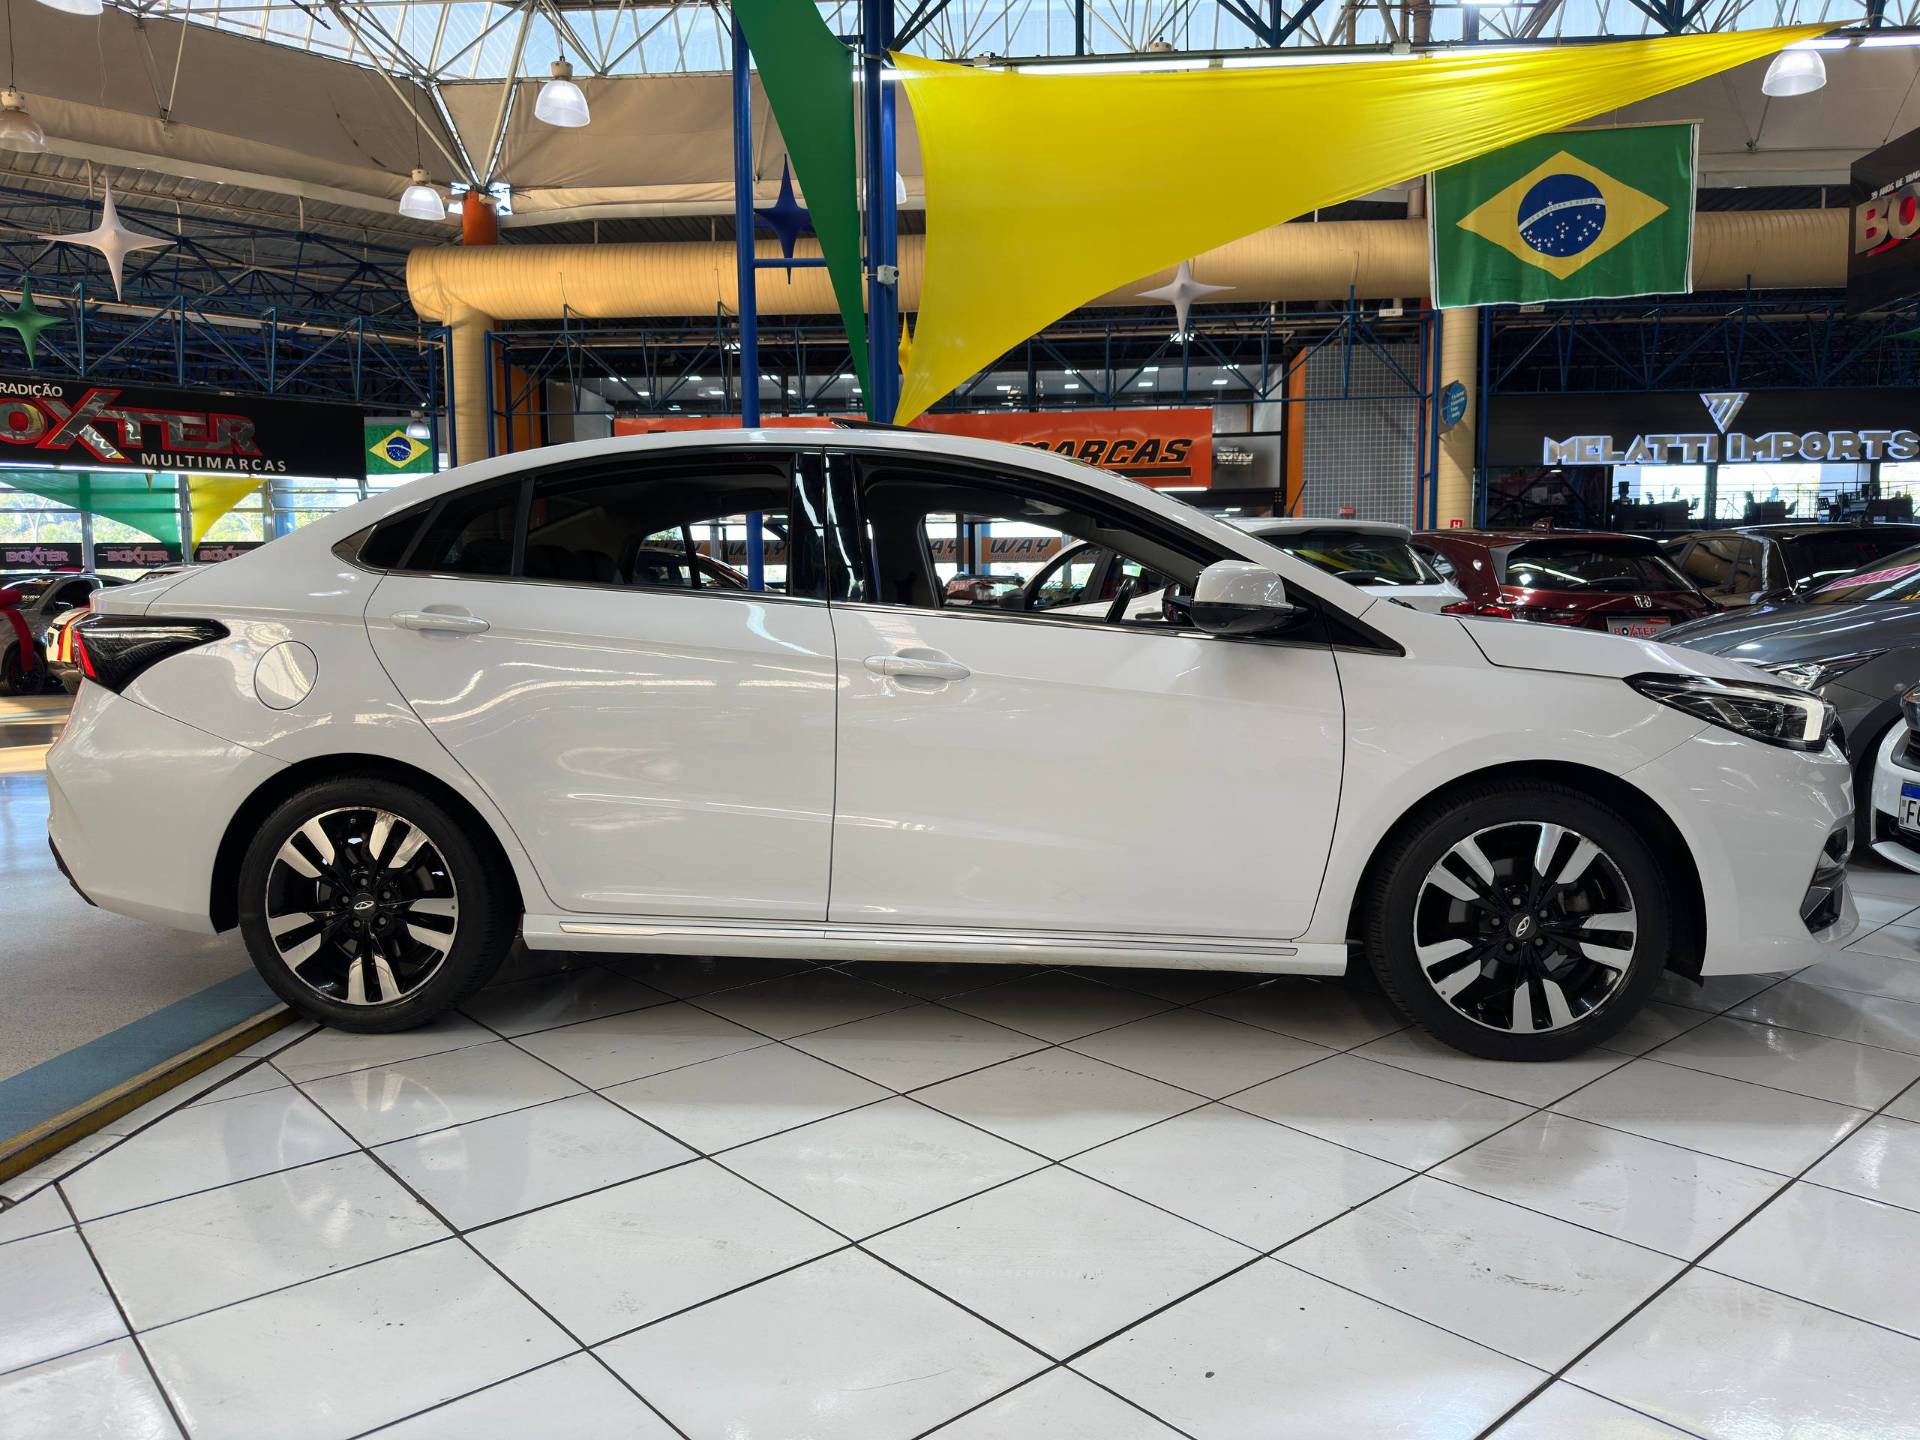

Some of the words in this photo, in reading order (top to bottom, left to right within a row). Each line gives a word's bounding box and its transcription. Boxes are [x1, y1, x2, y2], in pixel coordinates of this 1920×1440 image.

[0, 382, 63, 398] RADIÇÃO
[1544, 434, 1719, 465] MELATTI
[1727, 430, 1920, 462] IMPORTS
[141, 452, 287, 472] MULTIMARCAS
[990, 538, 1052, 553] WAY
[5, 546, 69, 566] BOXTER
[107, 546, 169, 565] BOXTER
